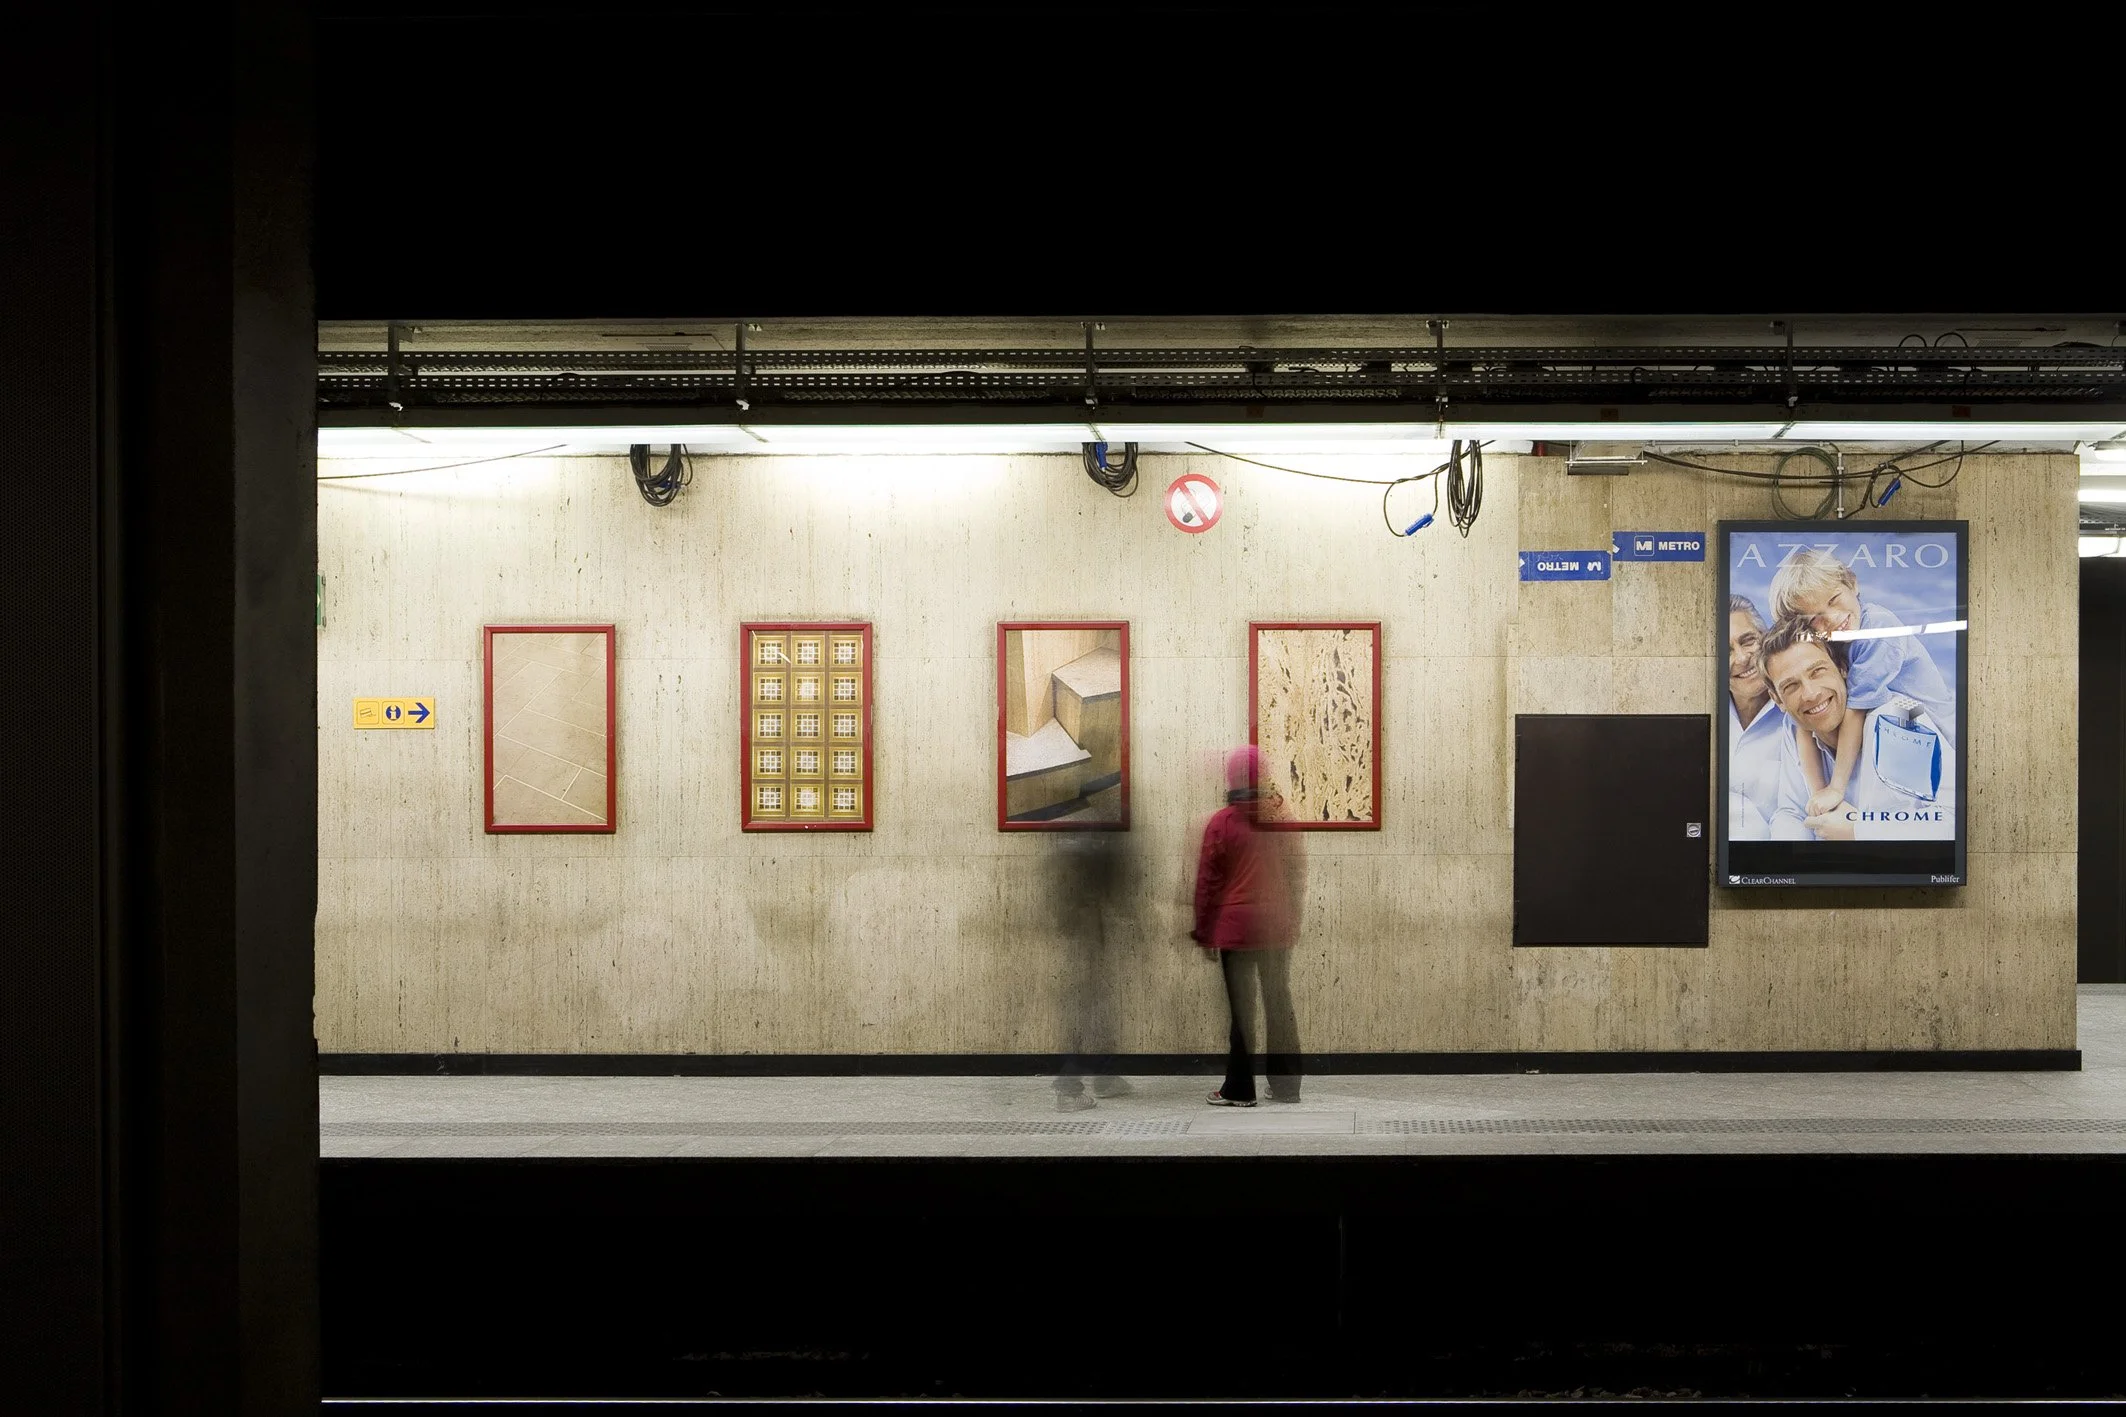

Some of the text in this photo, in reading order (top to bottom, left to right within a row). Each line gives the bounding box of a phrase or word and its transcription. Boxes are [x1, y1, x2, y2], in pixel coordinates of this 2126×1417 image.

[1658, 541, 1700, 551] METRO
[1737, 543, 1949, 568] AZZARO
[1537, 561, 1579, 571] METRO
[1846, 811, 1943, 821] CHROME
[1931, 874, 1960, 883] Publifer
